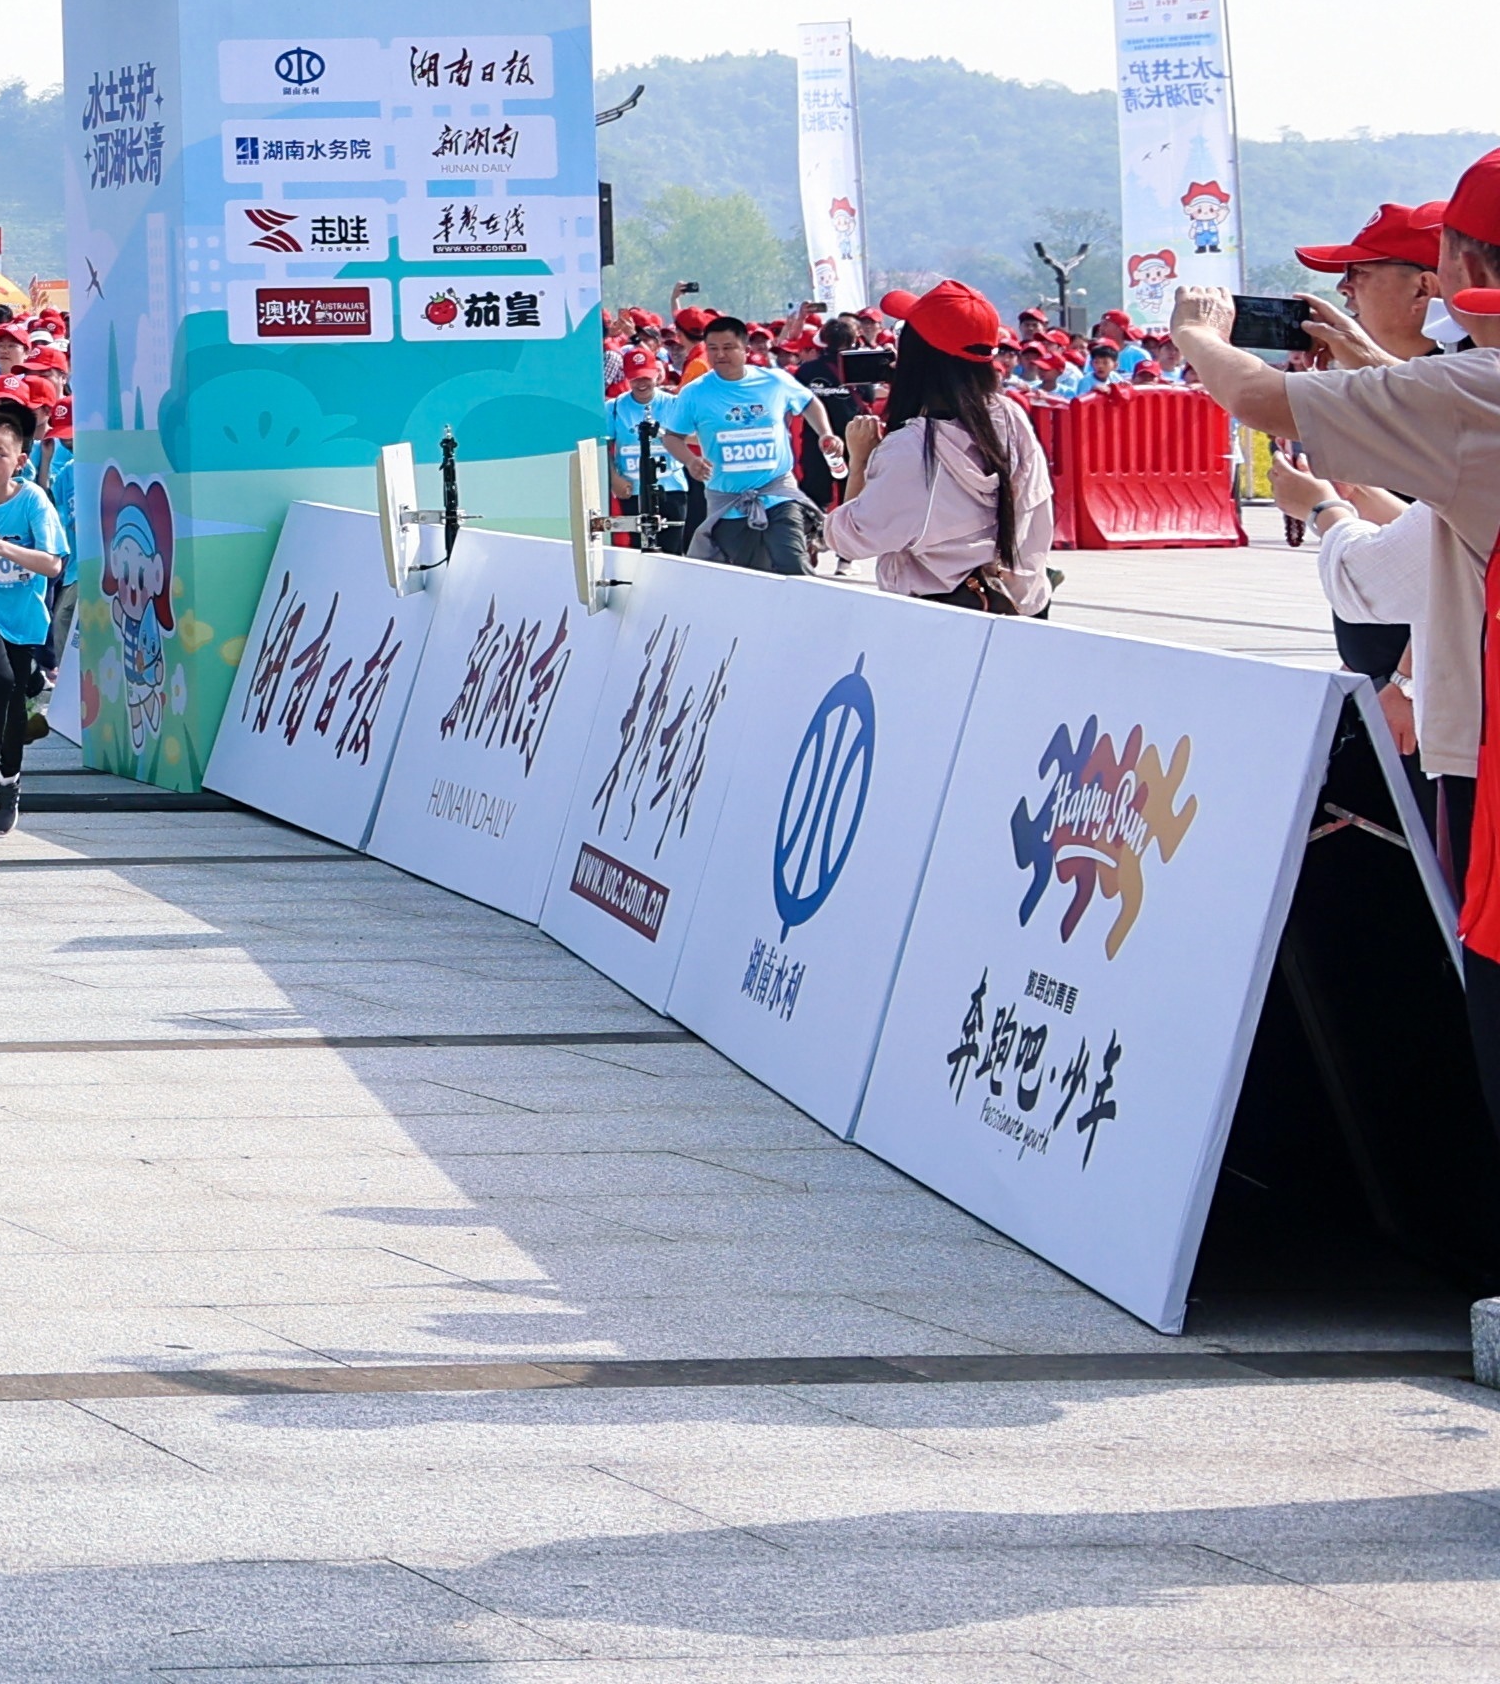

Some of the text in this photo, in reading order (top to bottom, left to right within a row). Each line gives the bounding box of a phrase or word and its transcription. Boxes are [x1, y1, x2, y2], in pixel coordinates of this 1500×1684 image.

[82, 61, 158, 130] 水土共护
[90, 121, 165, 191] 河湖长清
[262, 138, 372, 161] 湖南水务院
[432, 123, 518, 159] 新湖南
[441, 163, 512, 173] HUNAN DAILY
[311, 216, 369, 246] 走娃
[435, 243, 525, 253] www.voc.com.cn
[258, 300, 311, 326] 澳牧
[464, 292, 541, 328] 茄皇
[722, 442, 775, 462] B2007
[441, 593, 572, 778] 新湖南
[426, 778, 517, 838] HUNAN DAILY
[1043, 772, 1150, 856] Happy Run
[576, 848, 664, 932] www.voc.com.cn
[744, 937, 806, 1022] 湖南水利
[1024, 968, 1080, 1016] 激昂的青春
[980, 1096, 1023, 1140] Passionate
